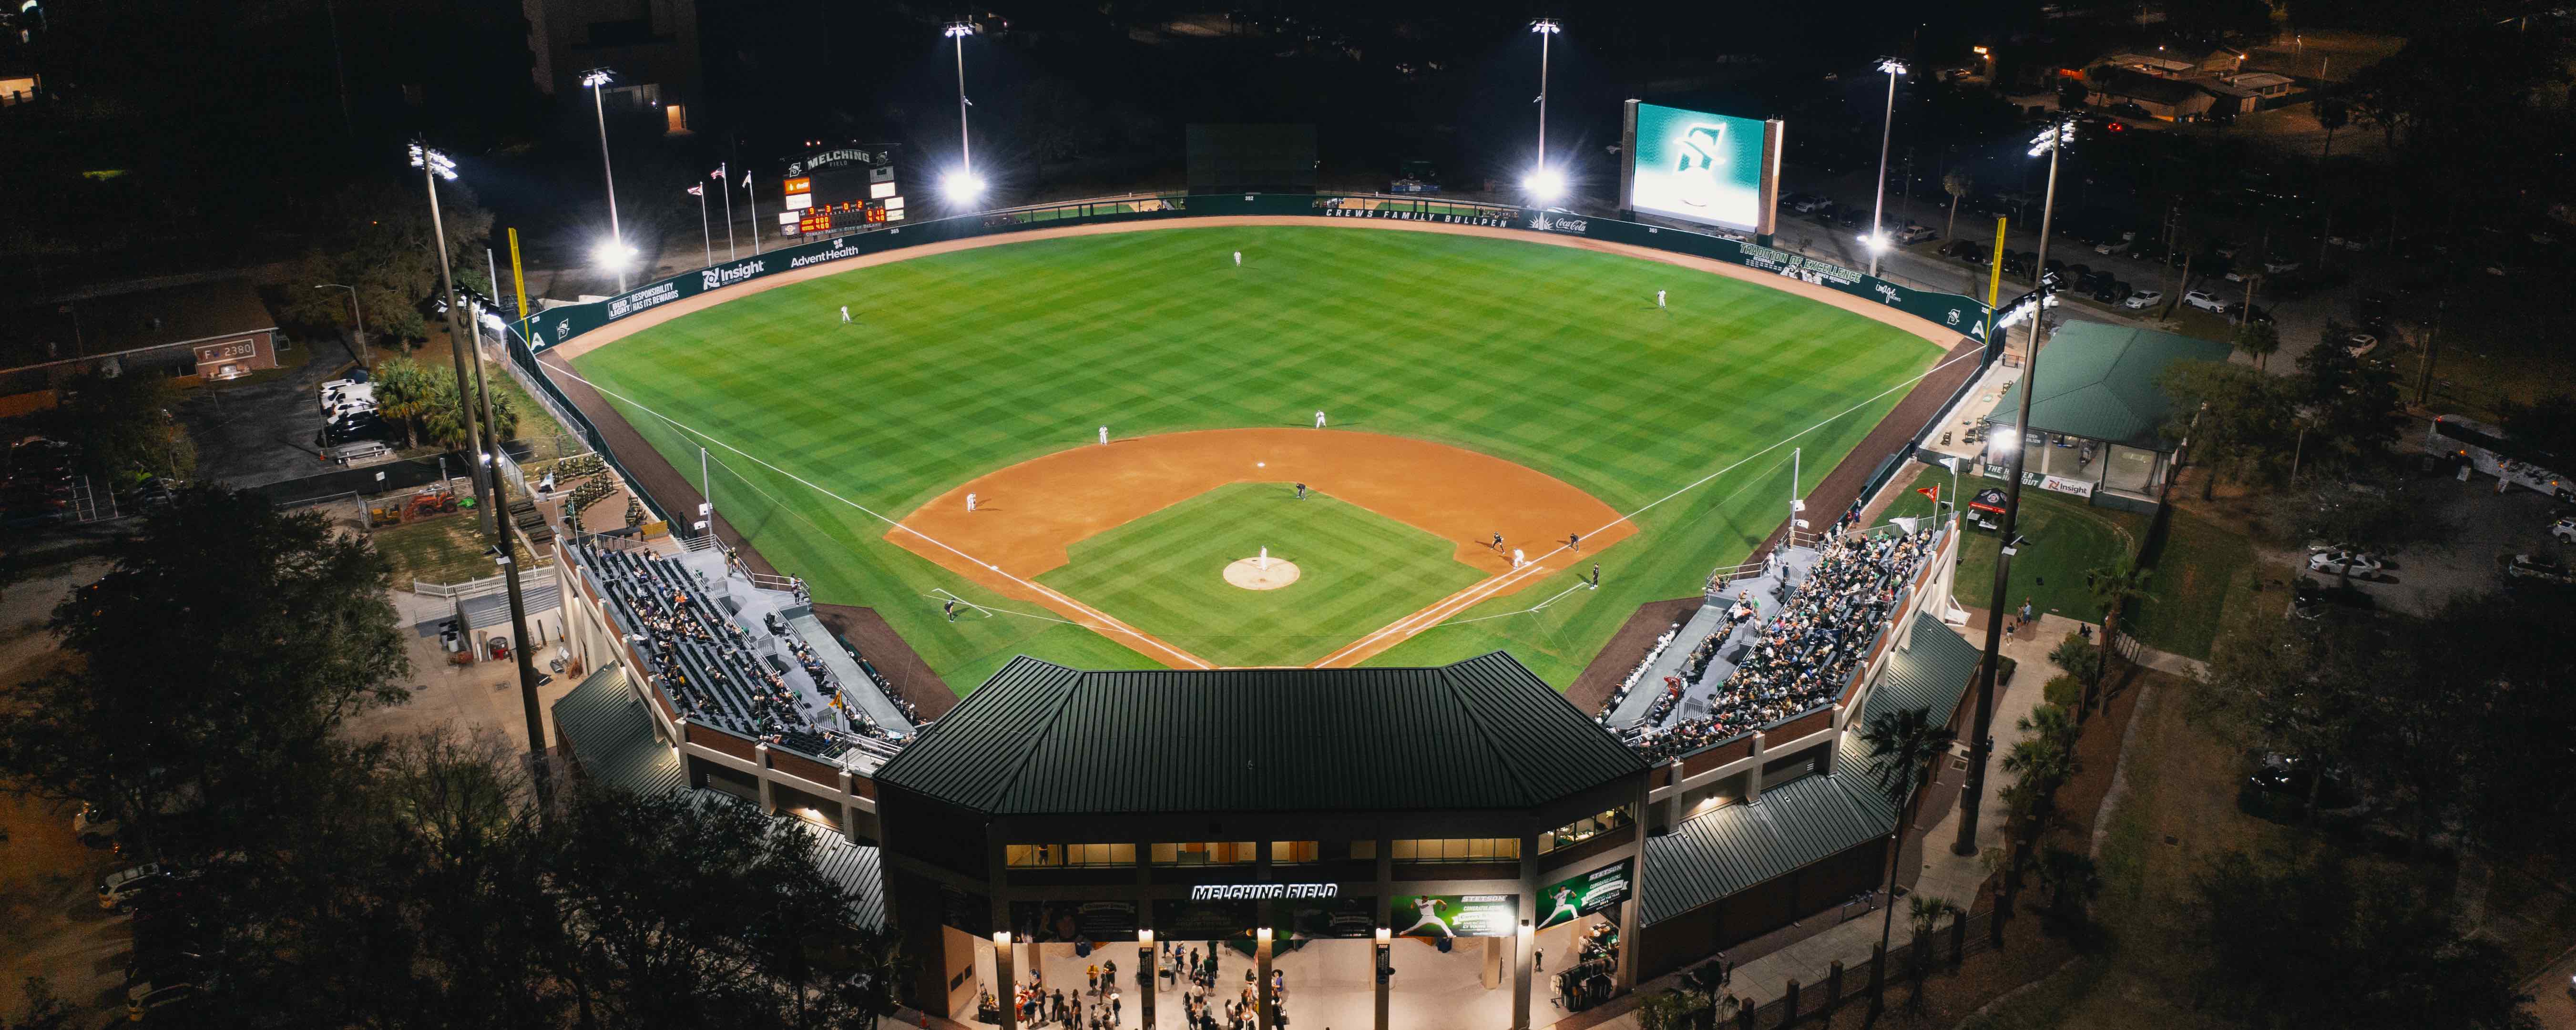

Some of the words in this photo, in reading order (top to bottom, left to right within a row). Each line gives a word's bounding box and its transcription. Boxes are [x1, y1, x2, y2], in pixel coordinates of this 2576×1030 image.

[808, 150, 869, 170] MELCHING
[1326, 209, 1373, 217] CREWS
[1383, 210, 1435, 222] FAMILY
[1445, 214, 1506, 228] BULLPEN
[721, 260, 764, 278] Insight
[1740, 244, 1788, 263] TRADITION
[1789, 255, 1803, 264] OF
[1803, 259, 1861, 283] EXCELLENCE
[1753, 256, 1774, 265] REGIONALS
[1829, 276, 1850, 285] REGIONALS
[632, 282, 673, 302] RESPONSIBILITY
[633, 301, 643, 311] HAS
[644, 298, 653, 307] ITS
[653, 290, 678, 305] REWARDS
[1875, 282, 1896, 304] image
[610, 305, 630, 317] LIGHT
[612, 299, 627, 310] BUD
[204, 350, 211, 359] F
[225, 344, 251, 356] 2380
[1988, 465, 2003, 473] THE
[2060, 482, 2087, 494] Insight
[1589, 863, 1625, 881] STETSON
[1192, 884, 1284, 900] MELCHING
[1286, 883, 1338, 898] FIELD
